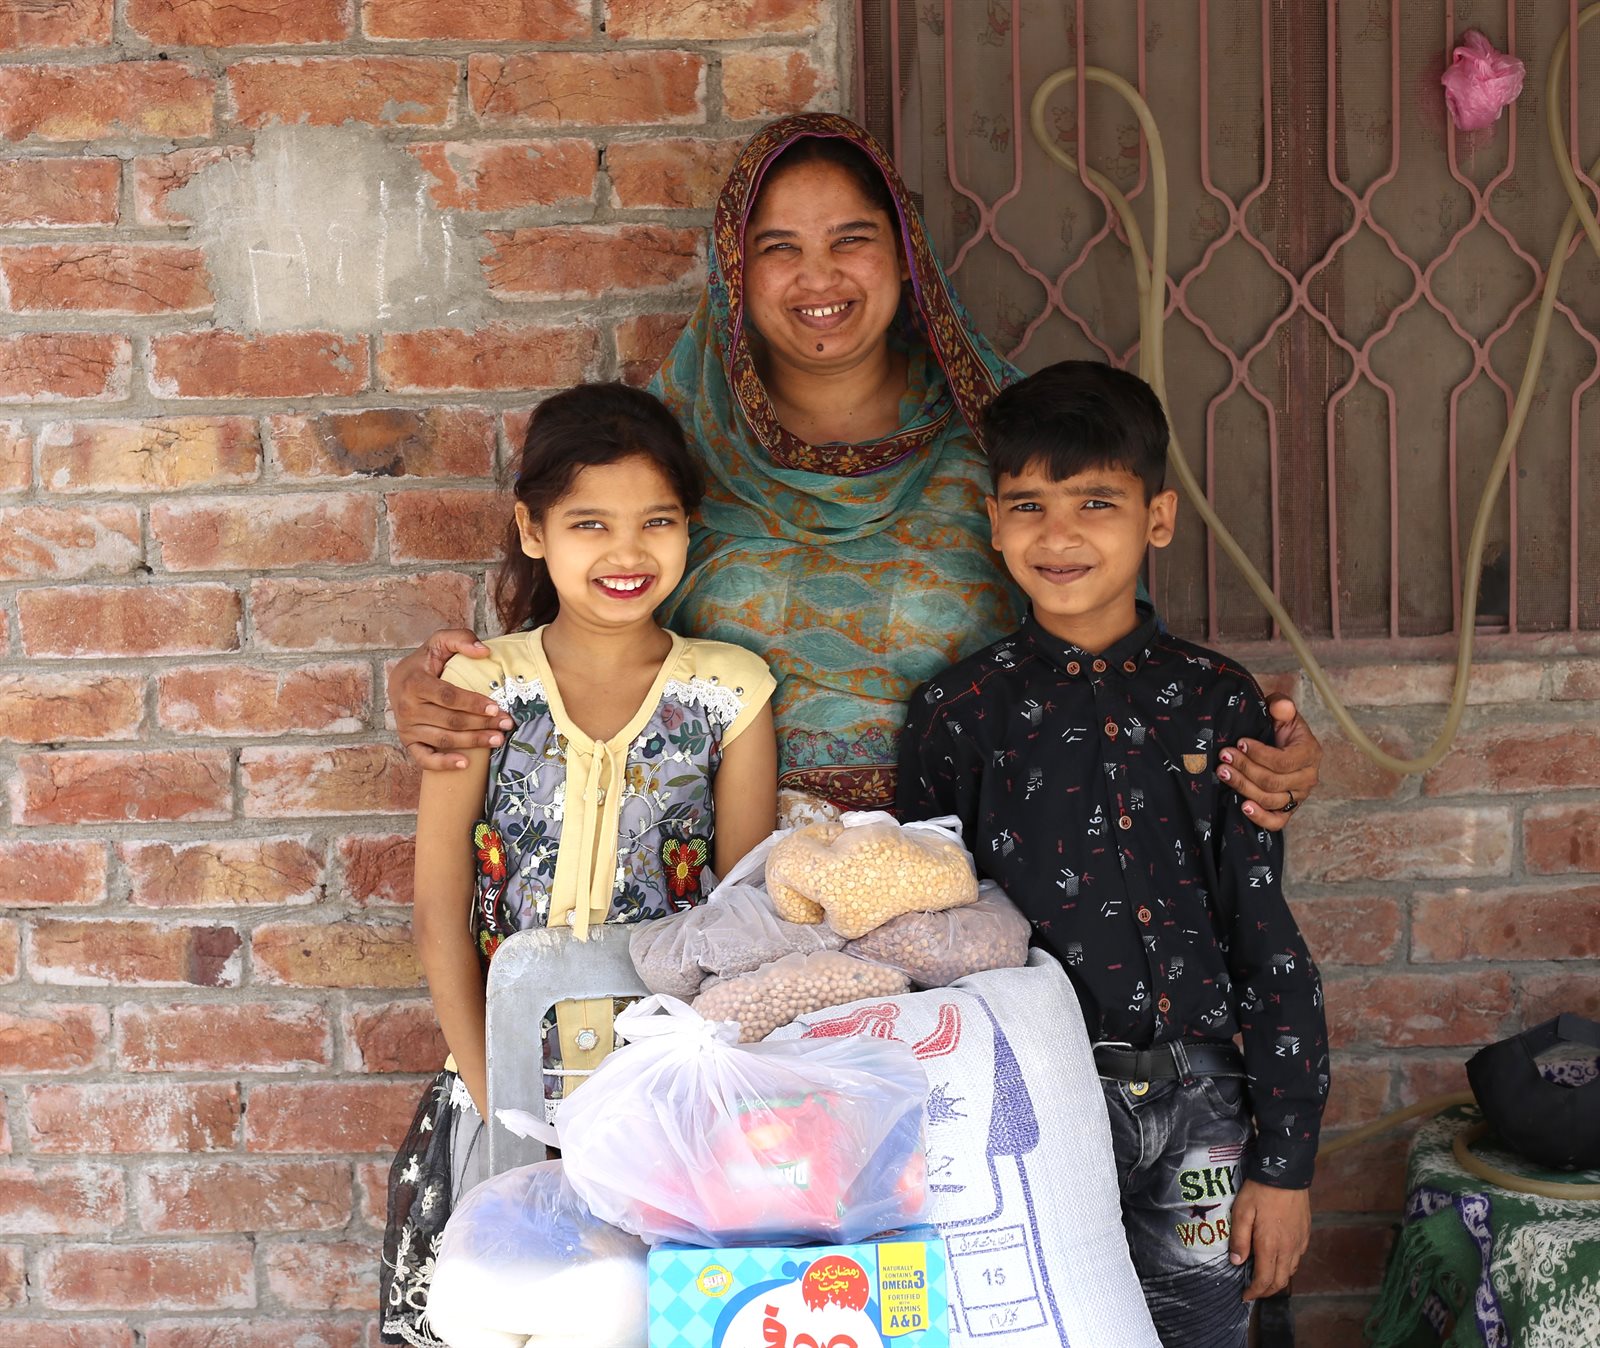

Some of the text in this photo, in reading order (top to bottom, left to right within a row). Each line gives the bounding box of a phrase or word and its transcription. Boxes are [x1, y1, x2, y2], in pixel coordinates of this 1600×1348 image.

[483, 887, 500, 931] NICE
[1175, 1218, 1231, 1248] WOR
[882, 1270, 925, 1290] OMEGA 3
[982, 1267, 1006, 1286] 15
[888, 1293, 921, 1301] FORTIFIED
[890, 1315, 900, 1328] A
[912, 1314, 921, 1327] D
